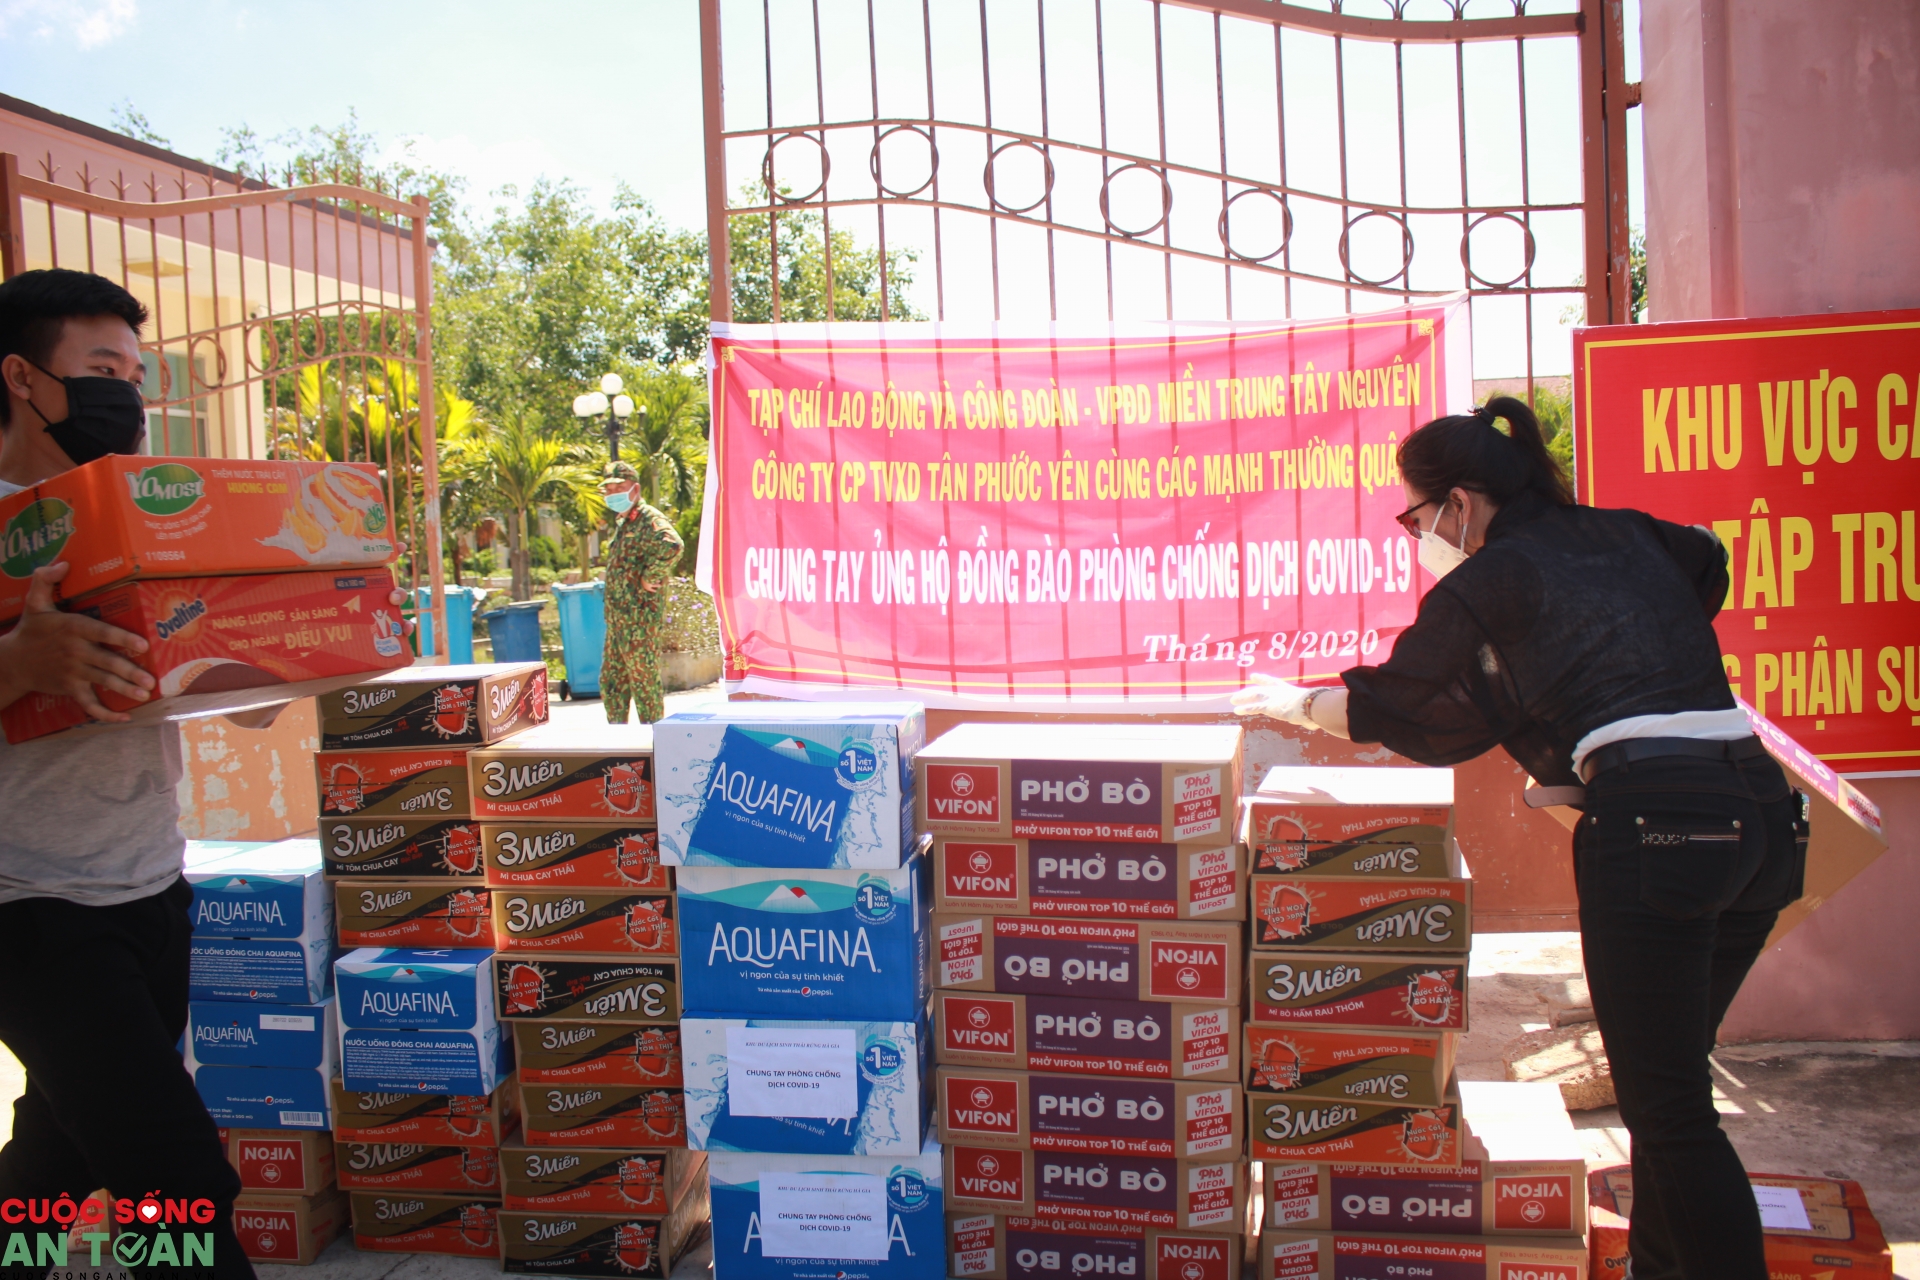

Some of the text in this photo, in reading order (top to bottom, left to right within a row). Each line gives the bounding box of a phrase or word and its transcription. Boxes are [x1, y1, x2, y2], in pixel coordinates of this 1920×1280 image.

[748, 388, 784, 436] TẠP
[789, 381, 823, 428] CHÍ
[827, 391, 865, 429] LAO
[871, 381, 926, 438] ĐỘNG
[930, 380, 957, 429] VÀ
[963, 380, 1017, 430] CÔNG
[1022, 377, 1078, 428] ĐOÀN
[1095, 383, 1151, 425] VPĐD
[1158, 363, 1211, 423] MIỀN
[1216, 375, 1285, 420] TRUNG
[1291, 361, 1331, 415] TÂY
[1338, 355, 1420, 410] NGUYÊN
[1643, 384, 1742, 473] KHU
[1759, 369, 1857, 485] VỰC
[752, 450, 805, 502] CÔNG
[811, 462, 835, 502] TY
[840, 462, 865, 502] CP
[869, 461, 921, 502] TVXD
[928, 452, 967, 501] TÂN
[975, 451, 1042, 501] PHƯỚC
[1048, 449, 1089, 501] YÊN
[1095, 448, 1150, 501] CÙNG
[1156, 445, 1197, 497] CÁC
[1203, 452, 1263, 503] MẠNH
[1270, 435, 1353, 490] THƯỜNG
[745, 522, 1411, 615] CHUNG TAY ỦNG HỘ ĐỒNG BÀO PHÒNG CHỐNG DỊCH COVID-19
[1712, 498, 1815, 630] TẬP
[155, 597, 207, 640] Ovaltine
[228, 624, 353, 651] CHO NGÀN ĐIỀU VUI
[1143, 629, 1379, 667] Tháng 8/2020
[1755, 635, 1863, 731] PHẬN
[342, 687, 397, 715] 3 Miền
[482, 759, 564, 797] 3 Miền
[1021, 775, 1151, 805] PHỞ BÒ
[487, 794, 563, 812] MÌ CHUA CAY THÁI
[707, 762, 836, 842] AQUAFINA
[935, 798, 992, 815] VIFON
[1182, 786, 1213, 800] VIFON
[1183, 799, 1212, 812] TOP 10
[725, 810, 806, 843] vị ngon của sự tinh khiết
[1178, 808, 1217, 824] THẾ GIỚI
[1039, 826, 1071, 836] VIFON
[1073, 828, 1094, 837] TOP
[1095, 826, 1111, 837] 10
[1113, 825, 1134, 838] THẾ
[1135, 828, 1159, 838] GIỚI
[1038, 853, 1167, 882] PHỞ BÒ
[863, 886, 873, 909] 1
[952, 876, 1011, 892] VIFON
[197, 899, 284, 926] AQUAFINA
[708, 921, 877, 973] AQUAFINA
[1157, 948, 1219, 966] VIFON
[740, 970, 845, 982] vị ngon của sự tinh khiết
[1004, 955, 1129, 985] PHỞ BÒ
[1266, 964, 1362, 1001] 3 Miền
[361, 990, 457, 1017] AQUAFINA
[1268, 1001, 1365, 1018] MÌ BÒ HẦM RAU THƠM
[195, 1025, 256, 1045] AQUAFINA
[345, 1037, 367, 1047] NƯỚC
[368, 1038, 389, 1048] UỐNG
[391, 1039, 413, 1048] ĐÓNG
[746, 1069, 771, 1077] CHUNG
[787, 1069, 813, 1078] PHÒNG
[815, 1069, 841, 1078] CHỐNG
[768, 1081, 820, 1089] DỊCH COVID-19
[244, 1147, 296, 1161] VIFON
[800, 1224, 851, 1232] DỊCH COVID-19
[819, 1212, 845, 1221] PHÒNG
[846, 1212, 872, 1221] CHỐNG
